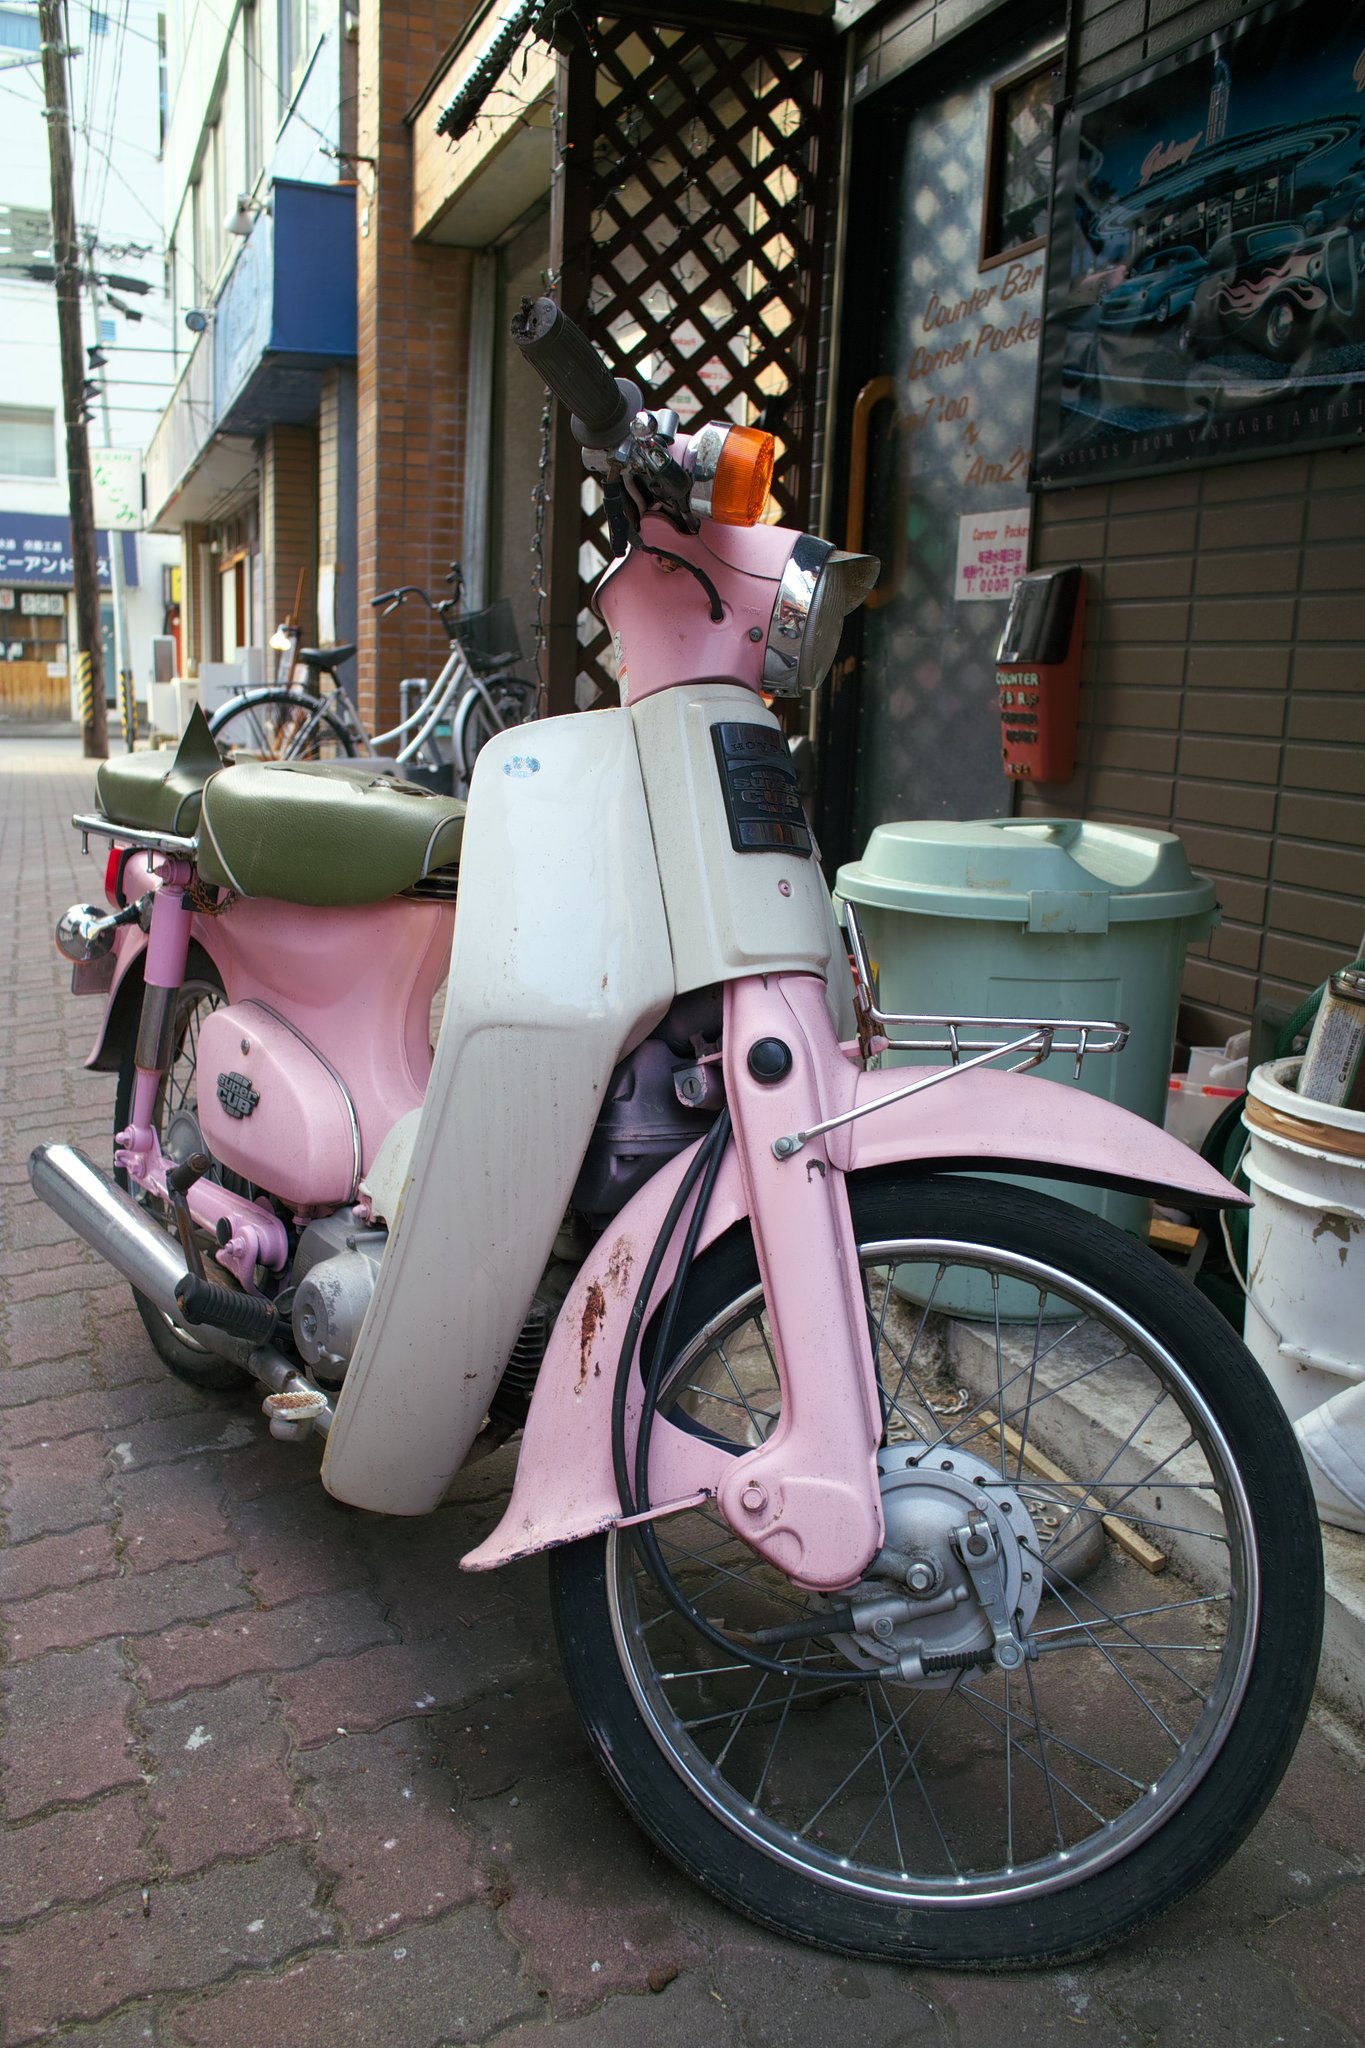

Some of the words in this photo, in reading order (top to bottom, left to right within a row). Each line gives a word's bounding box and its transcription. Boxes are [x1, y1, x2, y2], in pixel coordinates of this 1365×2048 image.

[922, 284, 998, 333] Counter
[1000, 262, 1044, 302] Bar
[908, 340, 971, 381] Corner
[974, 310, 1041, 358] Pocke
[1058, 443, 1120, 467] SCENES
[1131, 432, 1174, 454] FROM
[1189, 414, 1274, 443] VINTAGE
[973, 528, 998, 541] Corner
[995, 672, 1039, 686] COUNTER
[741, 789, 800, 808] CUB
[217, 1086, 252, 1115] CUB
